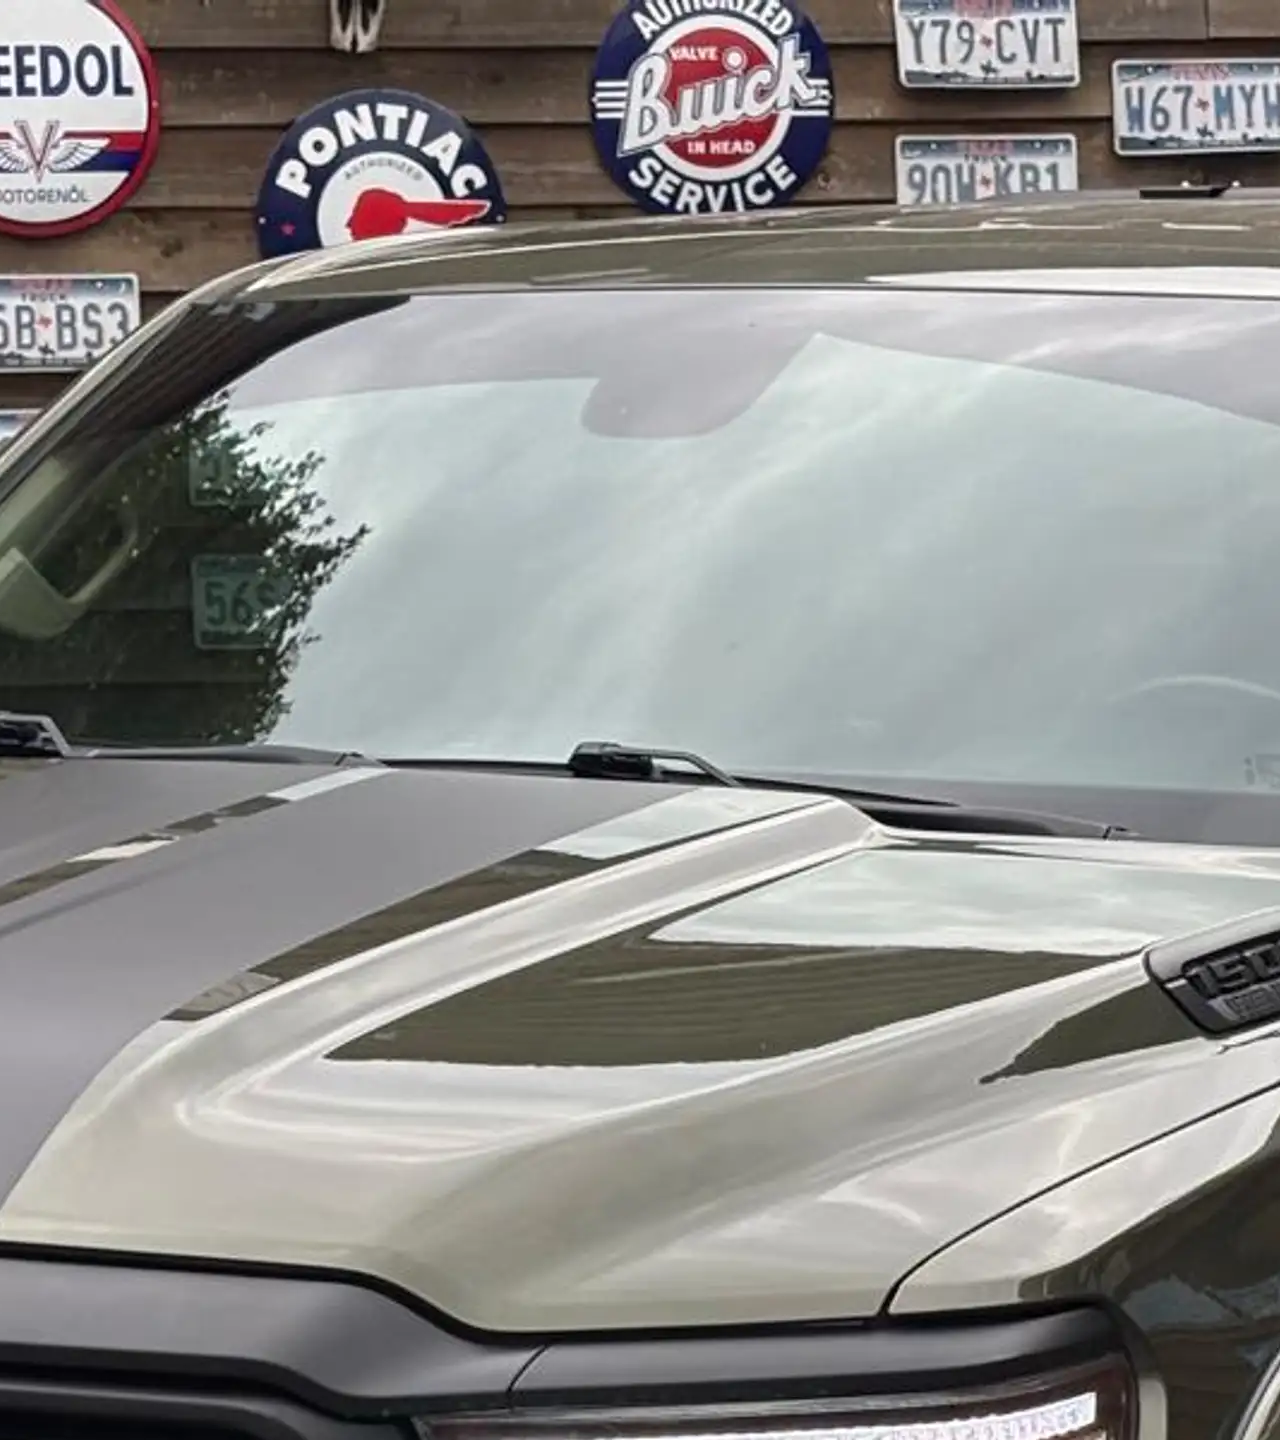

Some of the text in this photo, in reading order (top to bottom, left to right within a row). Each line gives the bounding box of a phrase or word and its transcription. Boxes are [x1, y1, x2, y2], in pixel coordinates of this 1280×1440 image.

[671, 46, 719, 62] VALVE
[617, 32, 817, 158] Buick
[275, 102, 488, 199] PONTIAC
[688, 140, 757, 155] IN HEAD
[628, 155, 798, 215] SERVICE
